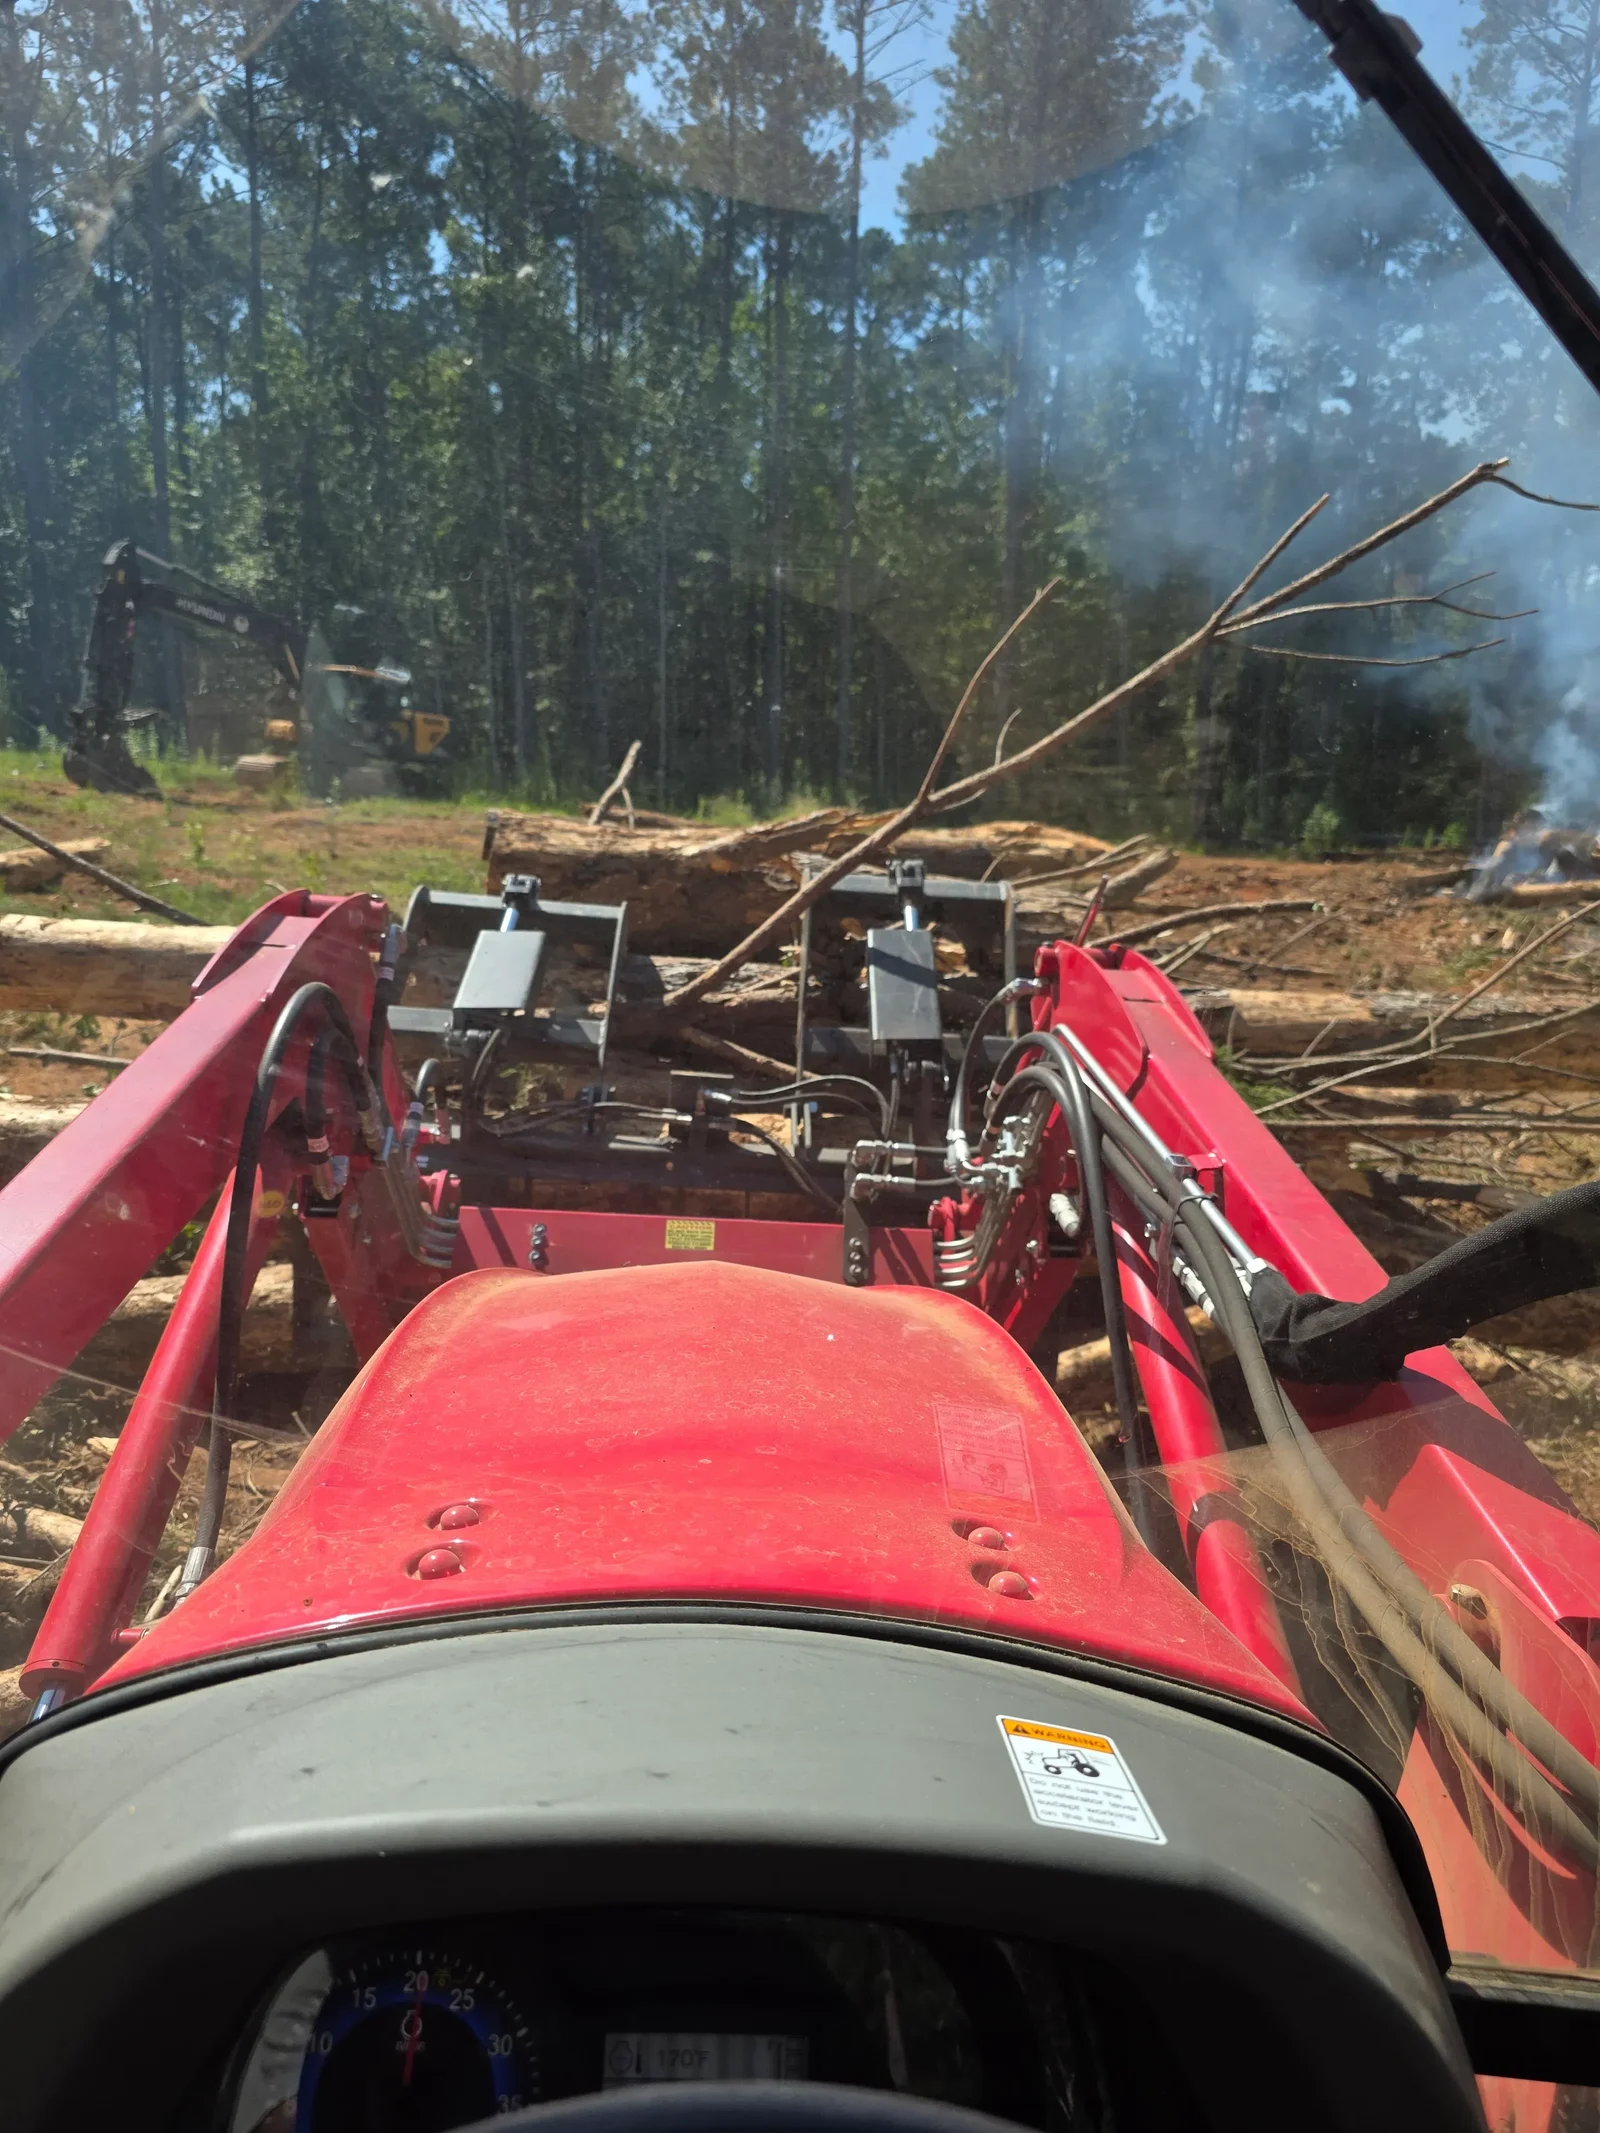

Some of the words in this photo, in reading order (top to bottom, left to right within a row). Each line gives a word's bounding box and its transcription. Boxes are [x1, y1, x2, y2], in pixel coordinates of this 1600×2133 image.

[1031, 1728, 1106, 1748] WARNING
[1029, 1777, 1047, 1786] Do
[1052, 1782, 1072, 1790] not
[1076, 1786, 1099, 1795] use
[1103, 1790, 1123, 1800] the
[1033, 1788, 1103, 1805] accelerator
[1108, 1800, 1138, 1811] lever
[1037, 1799, 1080, 1811] except
[1086, 1807, 1137, 1822] working
[1040, 1809, 1058, 1817] on
[1062, 1812, 1083, 1820] the
[403, 1970, 429, 1992] 20
[352, 1988, 377, 2010] 15
[449, 1989, 476, 2012] 25
[309, 2030, 334, 2054] 10
[487, 2034, 513, 2057] 30
